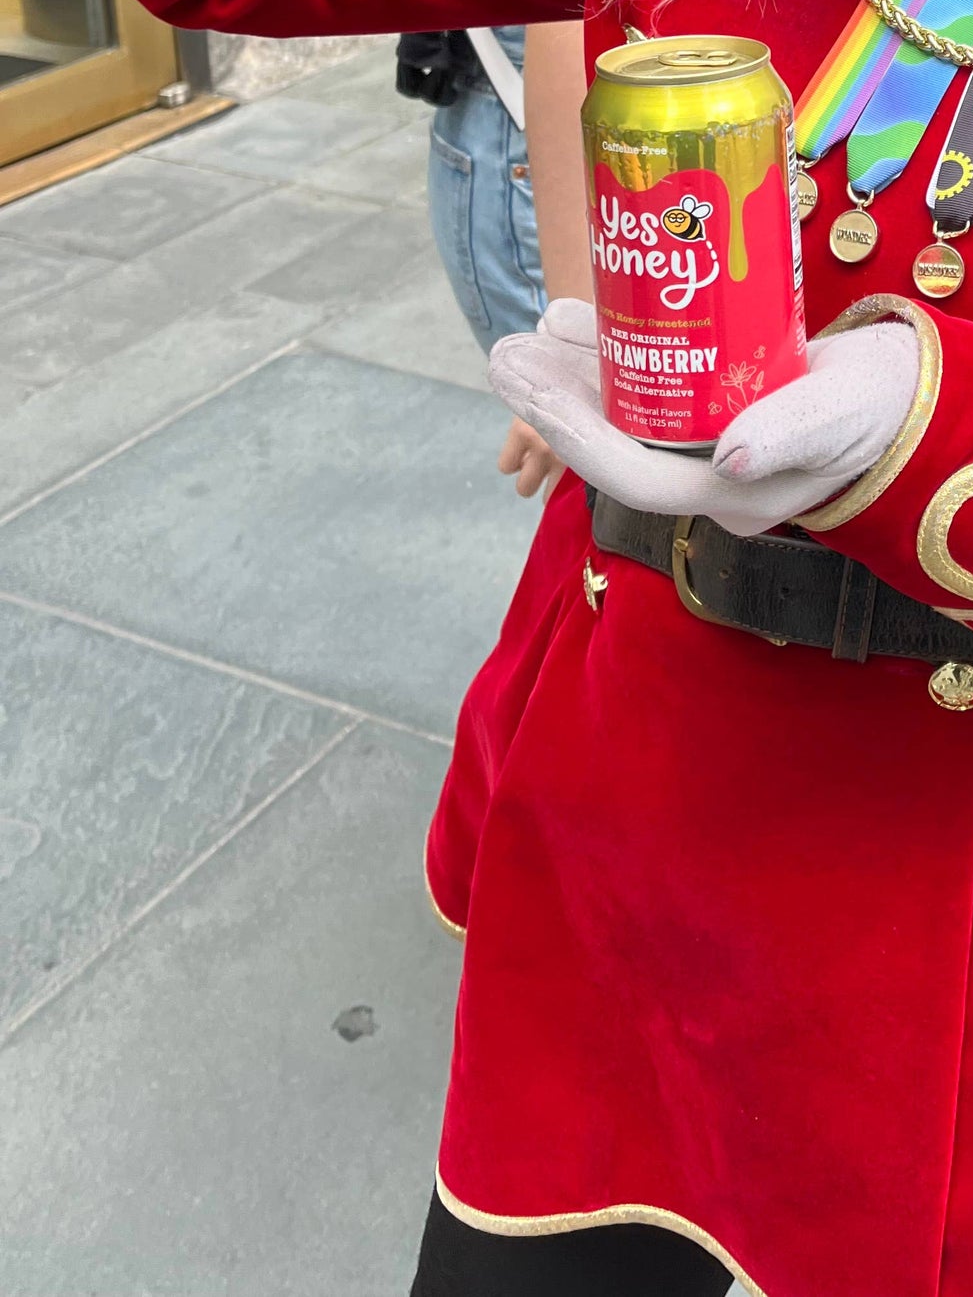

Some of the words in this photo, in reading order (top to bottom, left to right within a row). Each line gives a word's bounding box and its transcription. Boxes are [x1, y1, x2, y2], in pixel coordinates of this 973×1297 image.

[600, 194, 659, 247] Yes
[590, 224, 719, 310] Honey
[648, 317, 712, 329] Sweetened
[611, 327, 629, 340] BEE
[630, 333, 690, 346] ORIGINAL
[600, 333, 718, 374] STRAWBERRY
[619, 368, 655, 384] Caffeine
[657, 375, 683, 386] Free
[614, 377, 633, 392] Soda
[634, 385, 695, 397] Alternative
[632, 403, 659, 416] Natural
[660, 408, 692, 418] Flavors
[649, 418, 666, 428] (325
